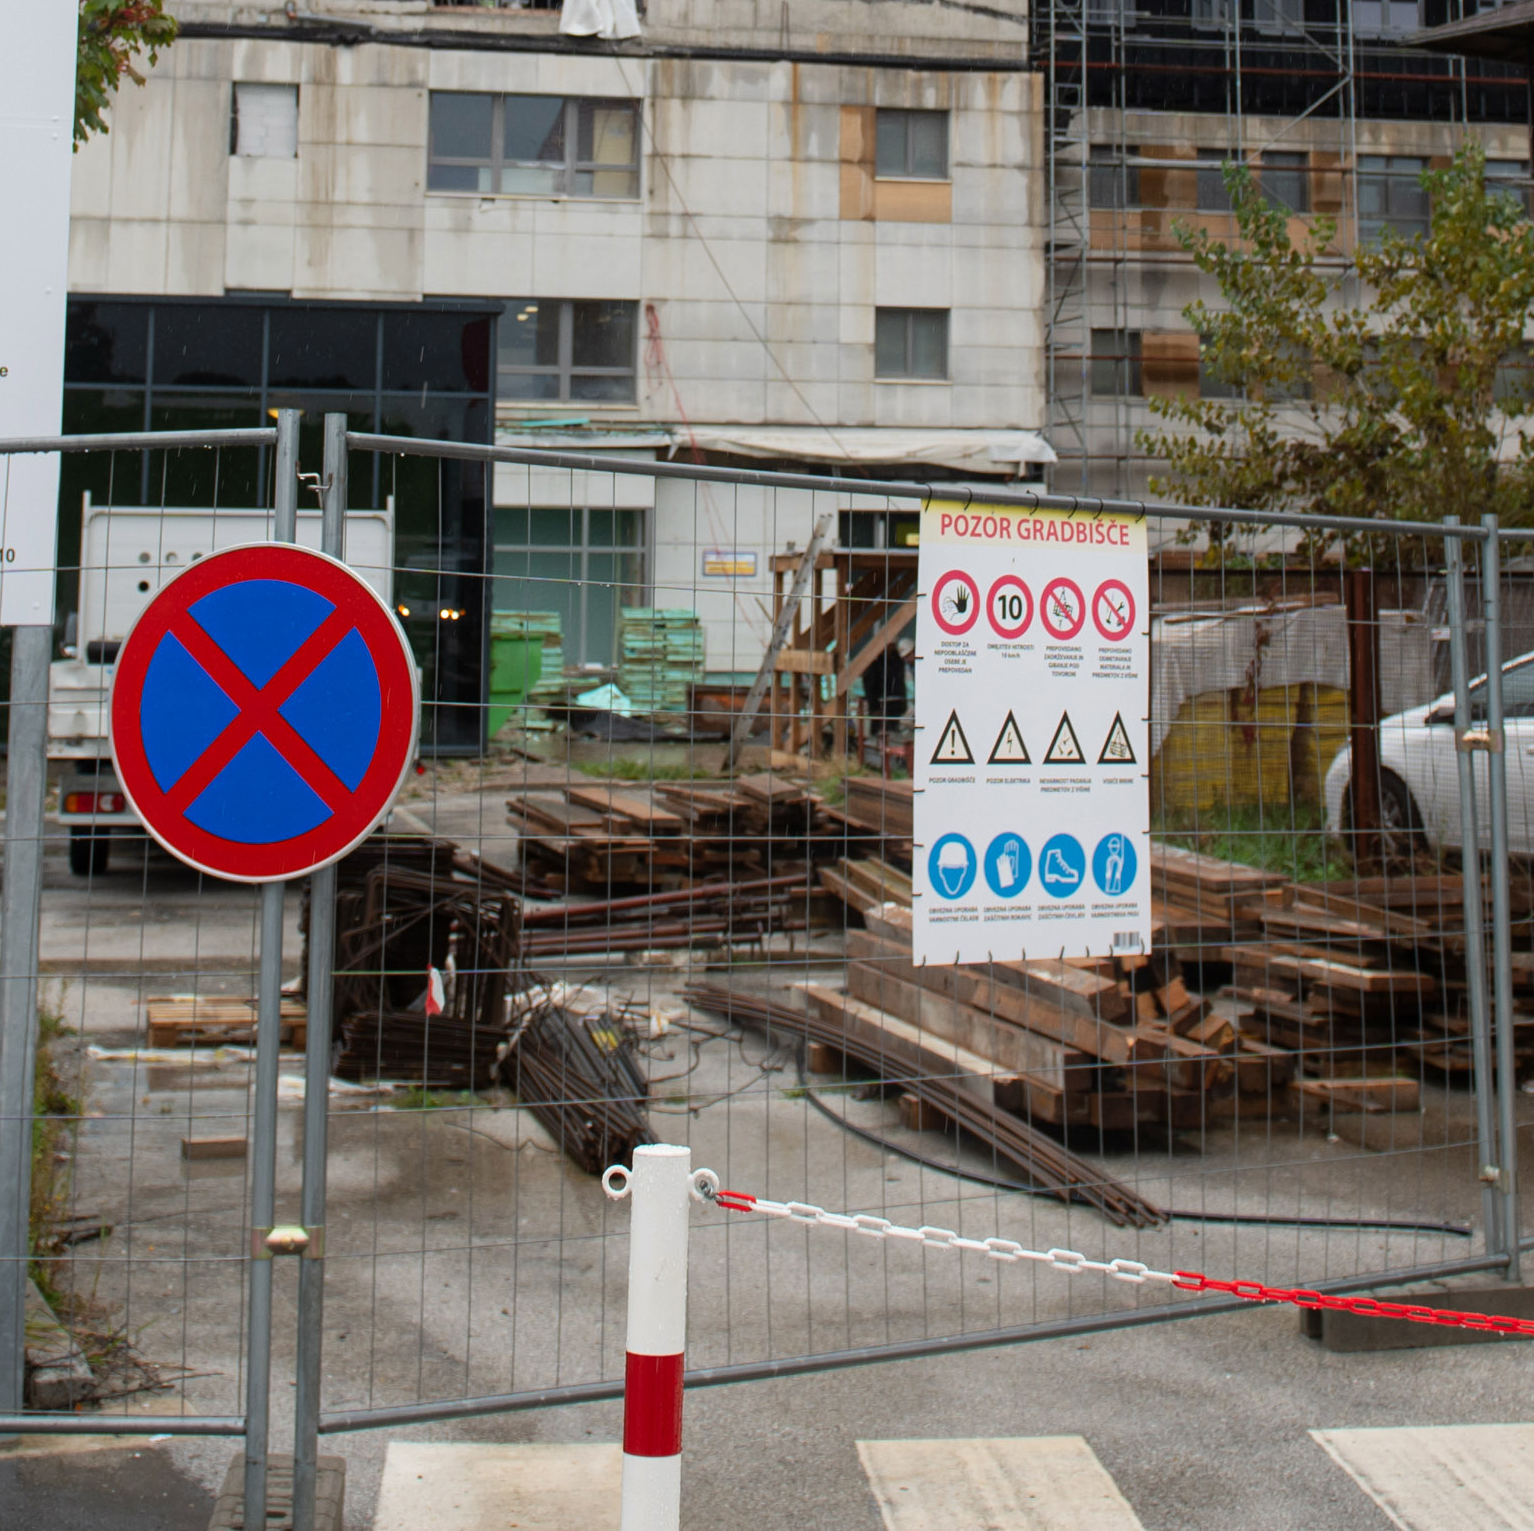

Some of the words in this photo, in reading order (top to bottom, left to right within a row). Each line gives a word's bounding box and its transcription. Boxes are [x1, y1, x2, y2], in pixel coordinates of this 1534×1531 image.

[940, 513, 1012, 540] POZOR
[1017, 516, 1130, 546] GRADBIŠČE
[998, 595, 1022, 620] 10
